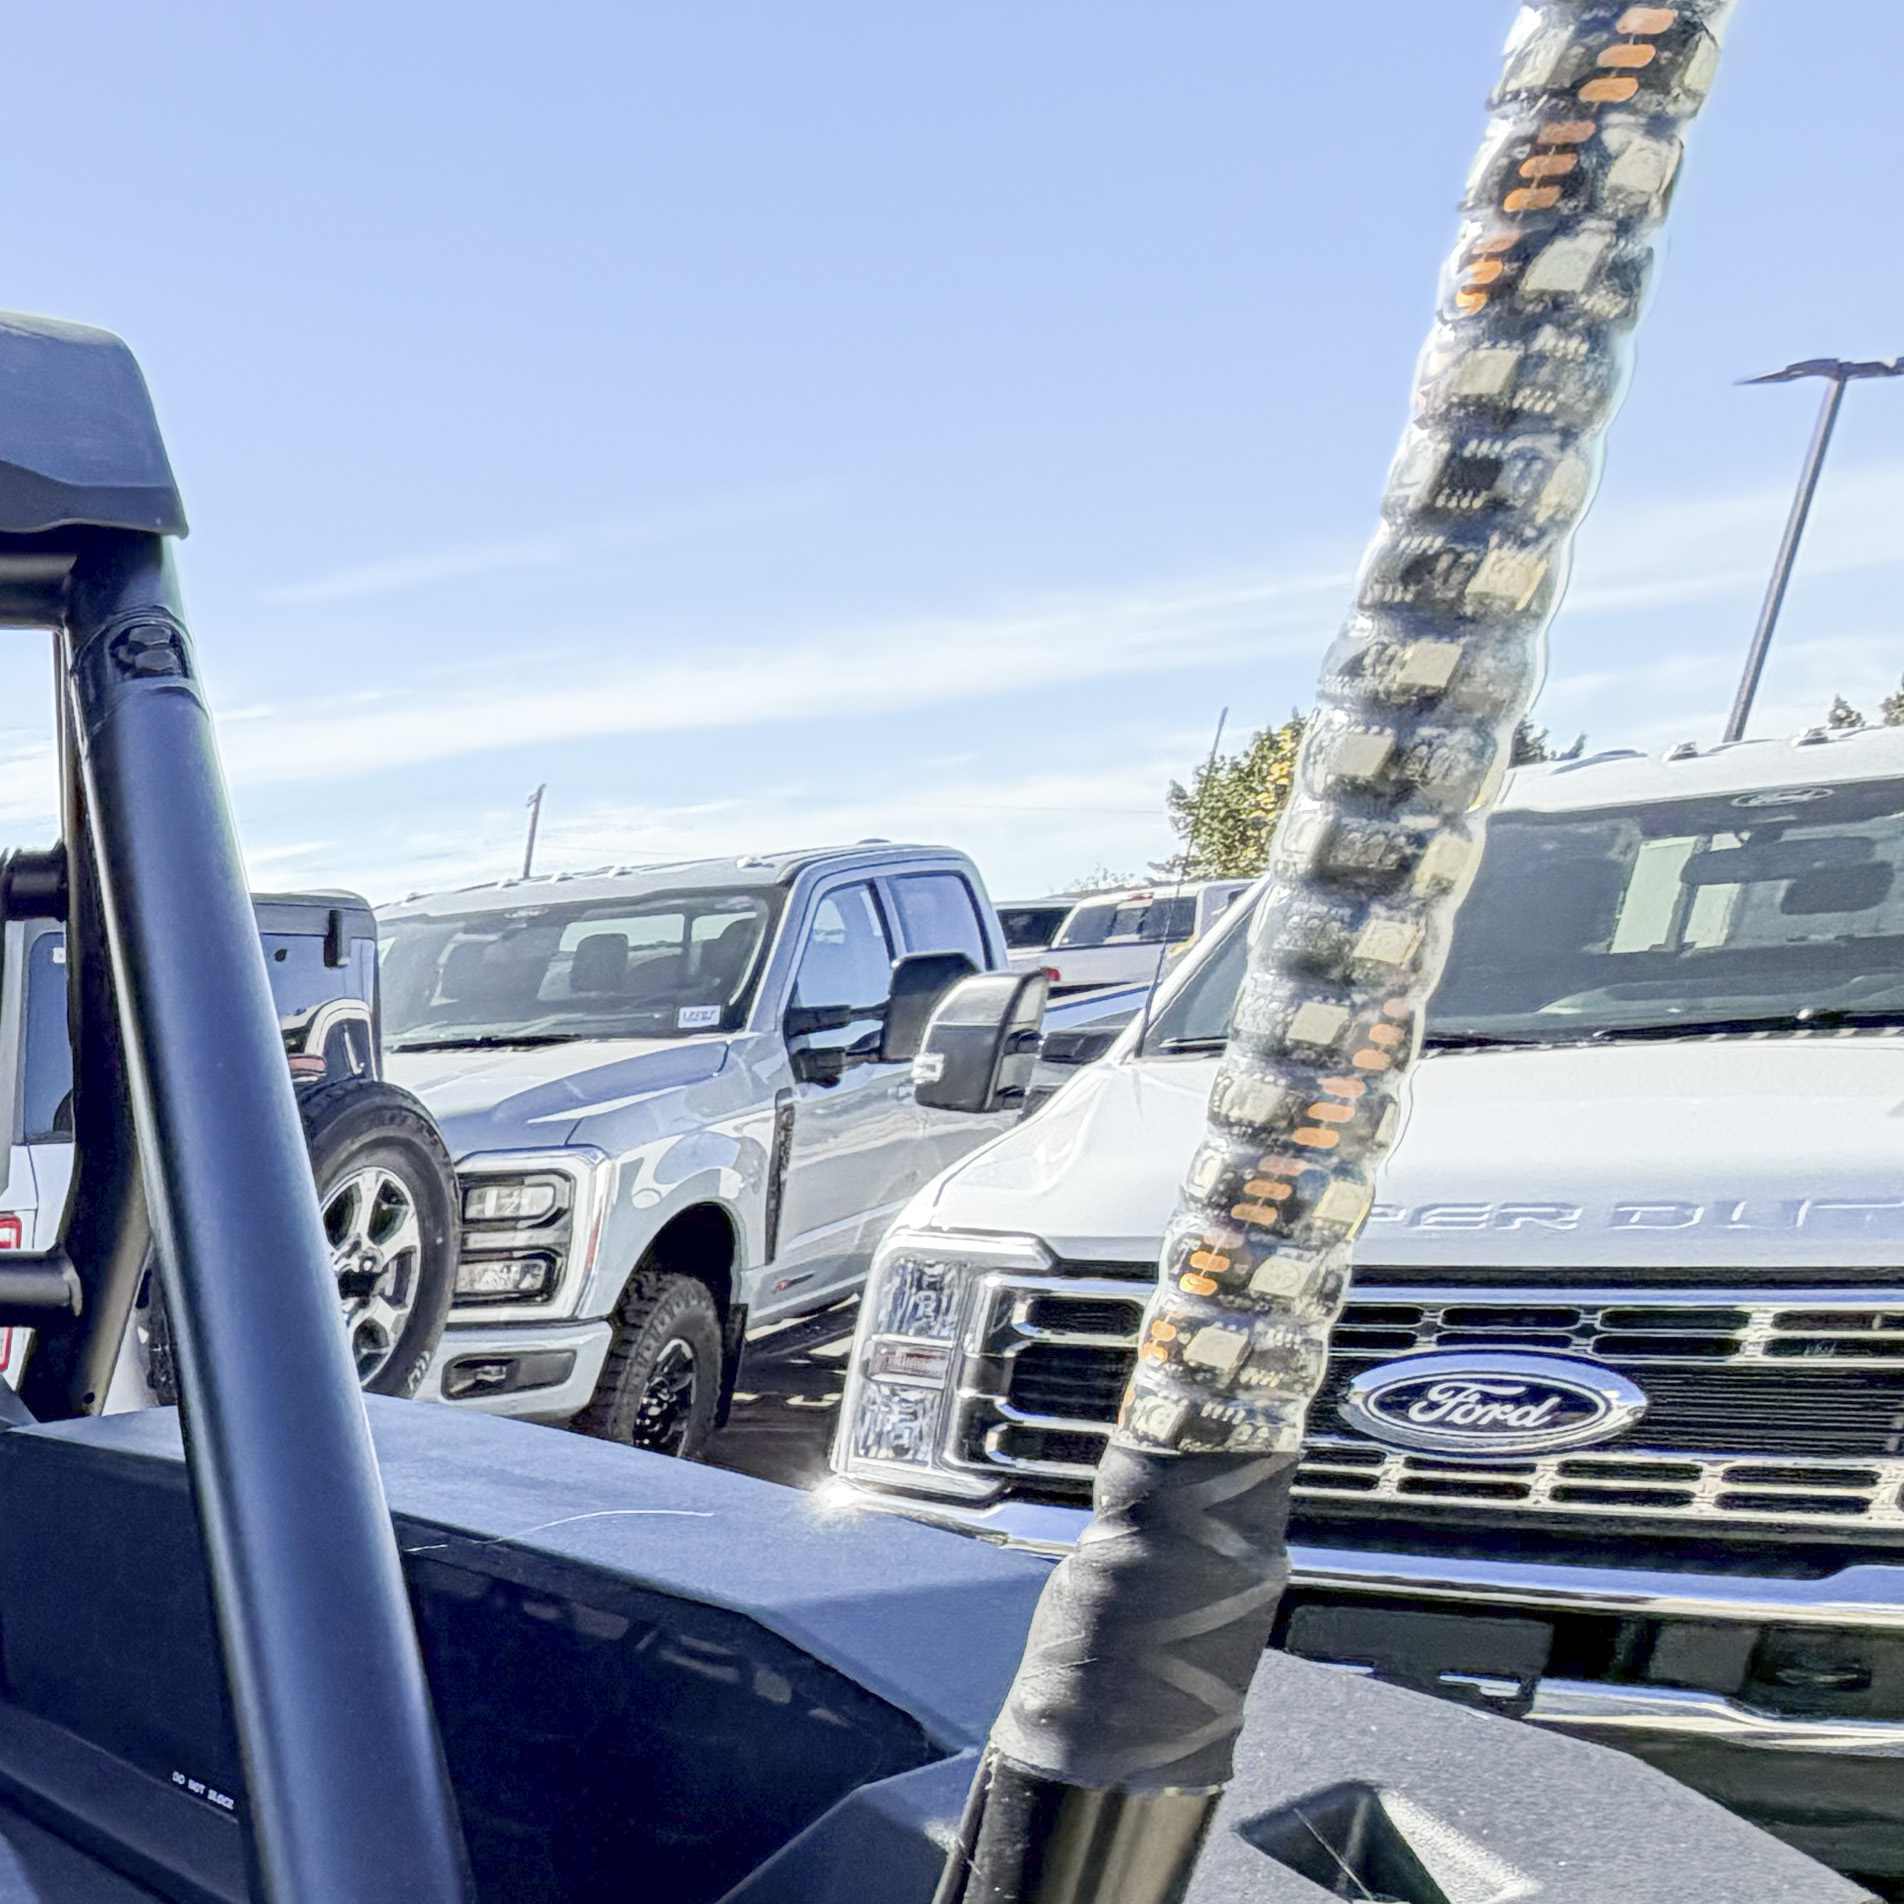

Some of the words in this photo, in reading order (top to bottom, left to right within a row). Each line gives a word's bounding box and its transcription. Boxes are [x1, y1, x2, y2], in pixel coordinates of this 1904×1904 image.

[1408, 1381, 1563, 1428] Ford
[172, 1770, 185, 1785] DO
[187, 1778, 206, 1795] NOT
[207, 1788, 235, 1810] BLOCK
